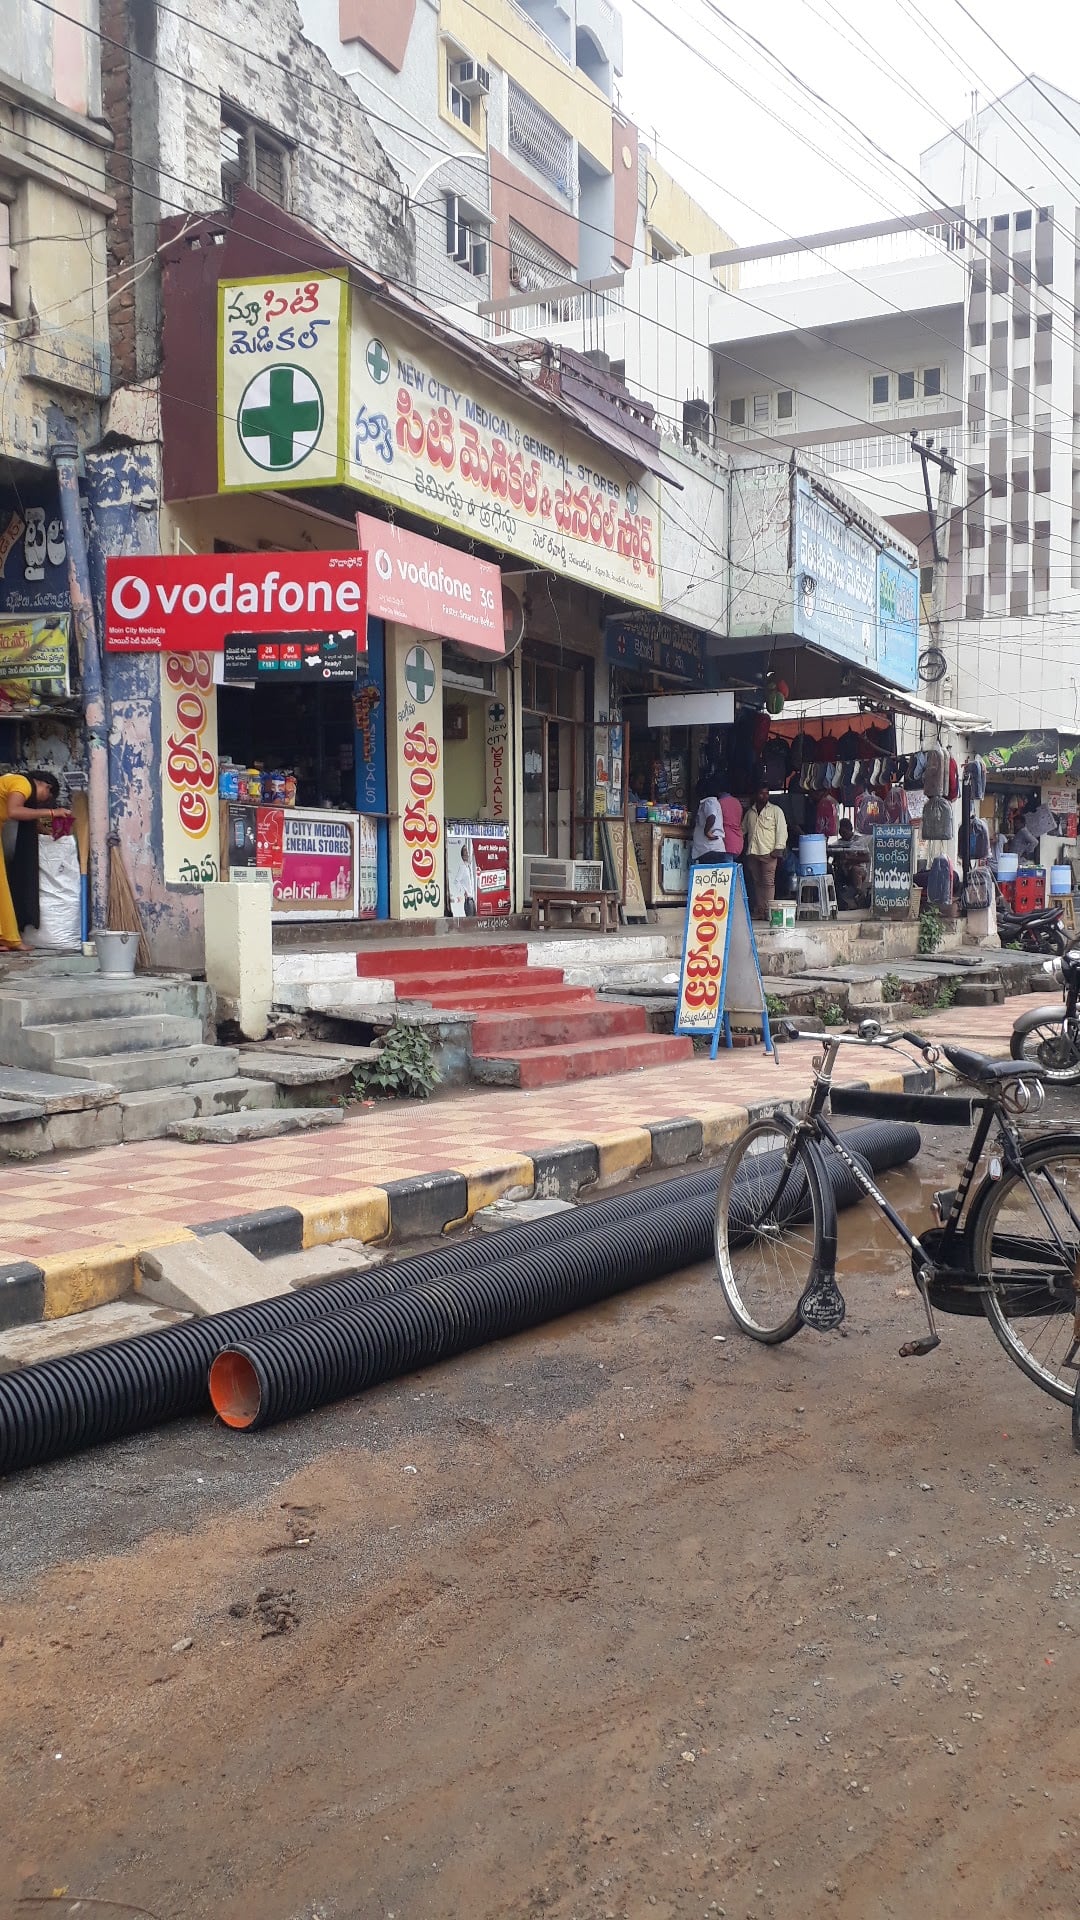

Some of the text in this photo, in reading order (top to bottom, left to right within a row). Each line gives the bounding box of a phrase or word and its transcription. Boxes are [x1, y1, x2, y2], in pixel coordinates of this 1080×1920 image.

[228, 291, 261, 326] న్యూ
[229, 319, 331, 355] మెడికల్
[397, 359, 620, 499] NEW CITY MEDICAL & GENERAL STORES
[459, 418, 541, 514] మెడికల్
[155, 571, 361, 615] vodafone
[397, 559, 495, 610] vodafone 3G
[125, 627, 138, 636] City
[265, 646, 273, 654] 28
[487, 732, 508, 746] CITY
[489, 723, 507, 733] NEW
[491, 746, 504, 817] MEDICALS
[286, 838, 349, 854] ENERAL STORES
[292, 823, 312, 837] CITY
[314, 824, 349, 839] MEDICAL
[481, 873, 498, 885] nise
[685, 888, 726, 1007] మందులు
[835, 1144, 887, 1206] BSA SUPREME
